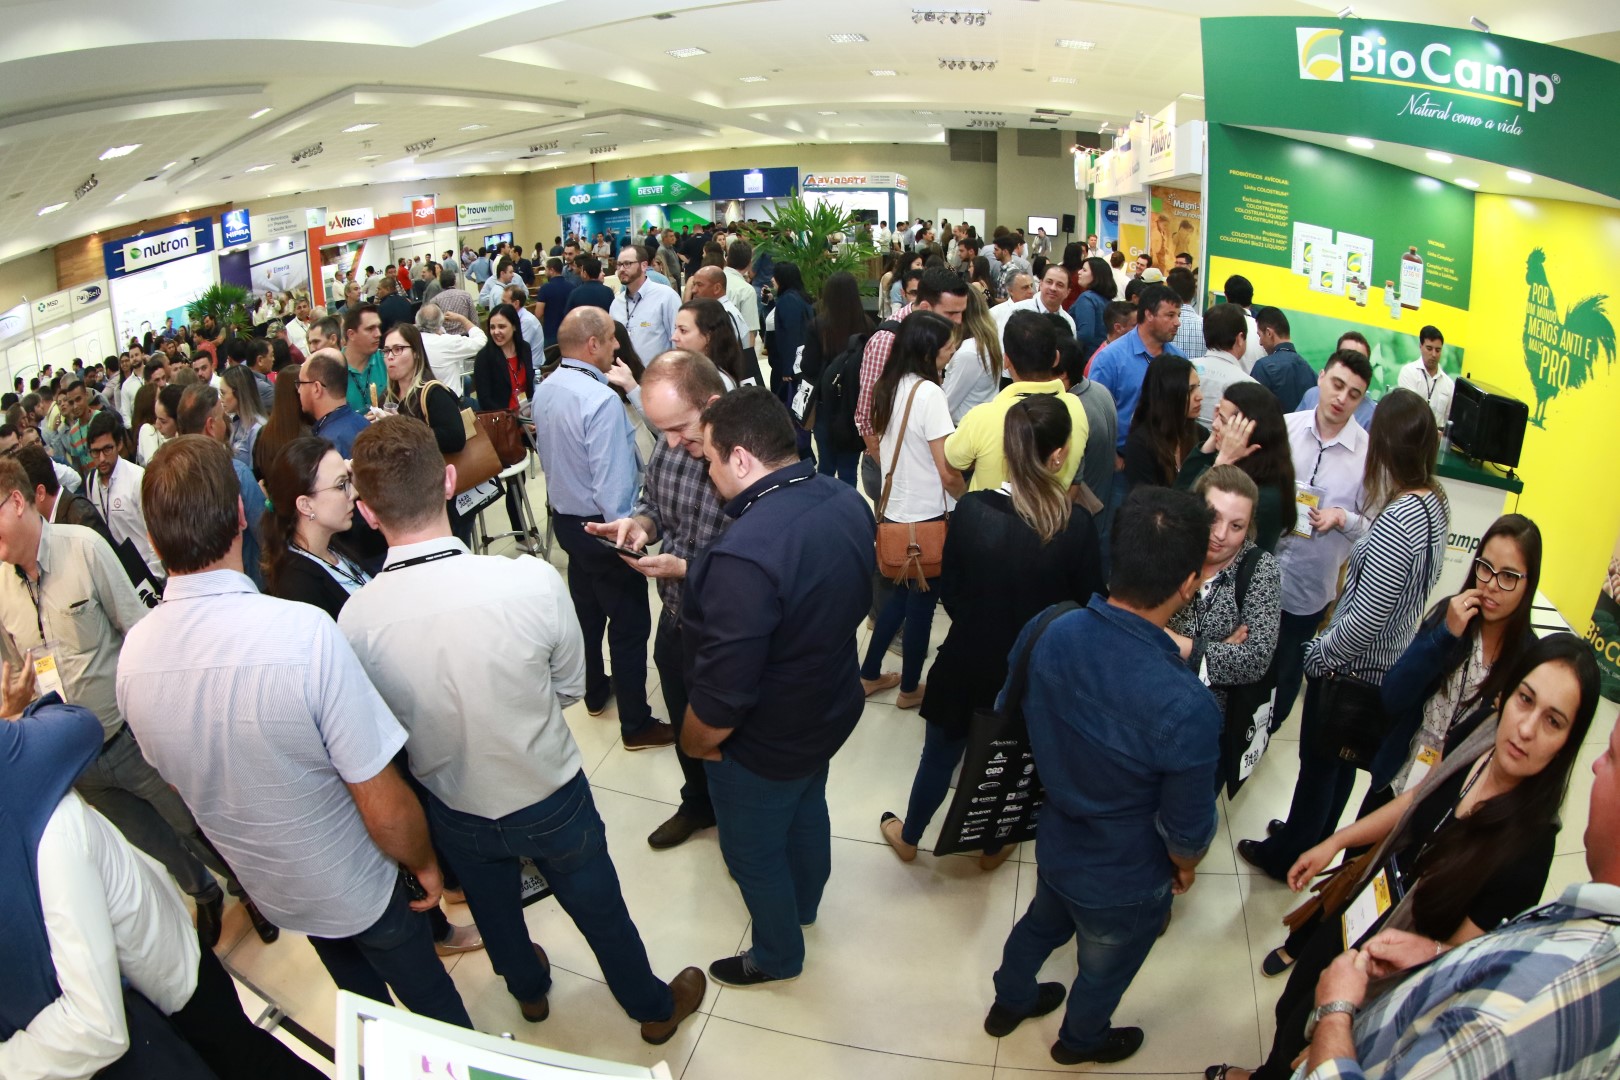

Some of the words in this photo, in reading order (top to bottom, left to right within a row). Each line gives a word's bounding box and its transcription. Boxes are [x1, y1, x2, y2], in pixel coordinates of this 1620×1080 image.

[1397, 92, 1453, 122] Natural
[1452, 110, 1483, 127] como
[1485, 119, 1494, 129] a
[1497, 115, 1524, 136] vida
[638, 185, 664, 196] DESVET
[467, 206, 487, 214] trouw
[488, 203, 512, 212] nutrition
[1235, 207, 1265, 216] COLOSTRUM
[1246, 202, 1277, 213] COLOSTRUM
[1243, 214, 1274, 224] COLOSTRUM
[225, 229, 250, 239] HIPRA
[1231, 230, 1262, 241] COLOSTRUM
[1220, 235, 1250, 245] COLOSTRUM
[144, 237, 189, 258] nutron
[1532, 282, 1549, 307] POR
[47, 299, 59, 307] MSD
[1527, 302, 1536, 316] UM
[1536, 304, 1557, 324] MUNDO
[1527, 315, 1559, 346] MENOS
[1559, 328, 1583, 358] ANTI
[1584, 338, 1593, 361] E
[1528, 337, 1544, 356] MAIS
[1538, 346, 1571, 389] PRÓ
